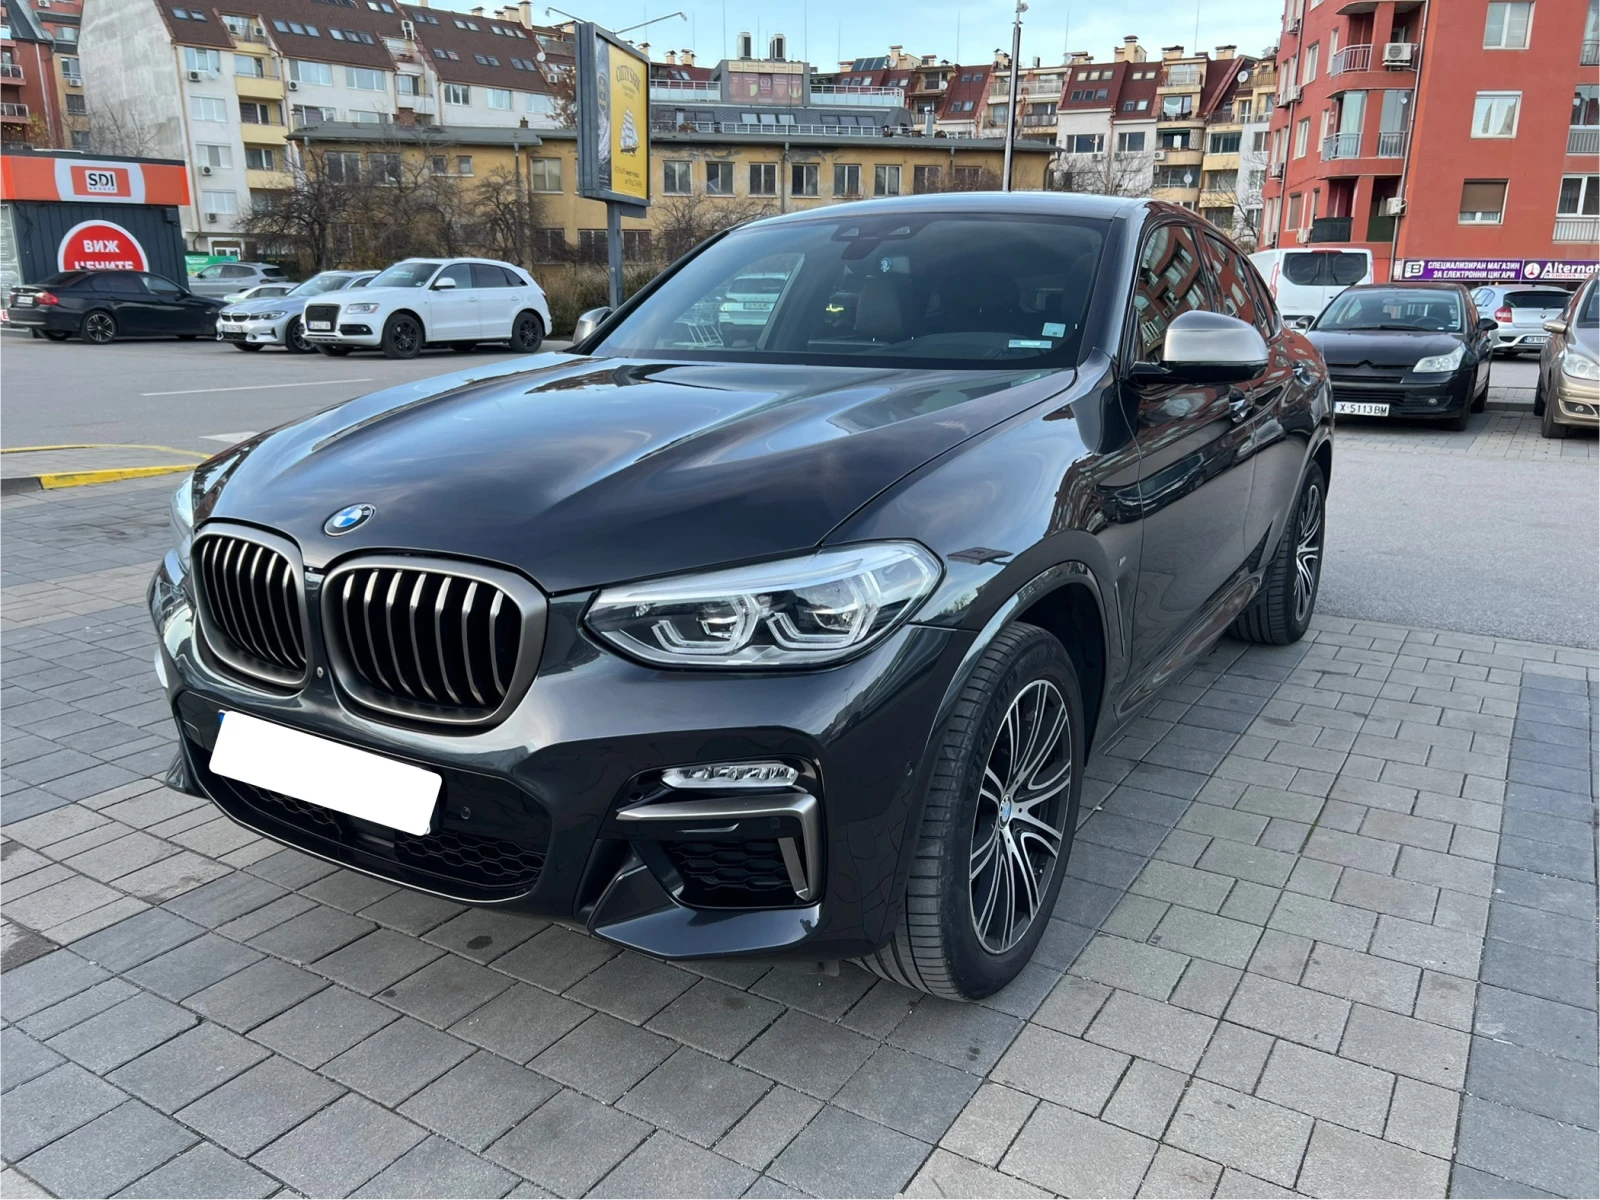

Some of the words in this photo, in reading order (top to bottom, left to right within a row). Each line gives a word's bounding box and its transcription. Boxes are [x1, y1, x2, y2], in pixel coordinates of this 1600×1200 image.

[88, 173, 115, 187] SDI
[83, 240, 120, 253] ВИЖ
[1428, 261, 1487, 270] СПЕЦИАЛИЗИРАН
[1488, 262, 1520, 270] МАГАЗИН
[1443, 271, 1486, 279] ЕЛЕКТРОННИ
[1488, 271, 1515, 279] ЦИГАРИ
